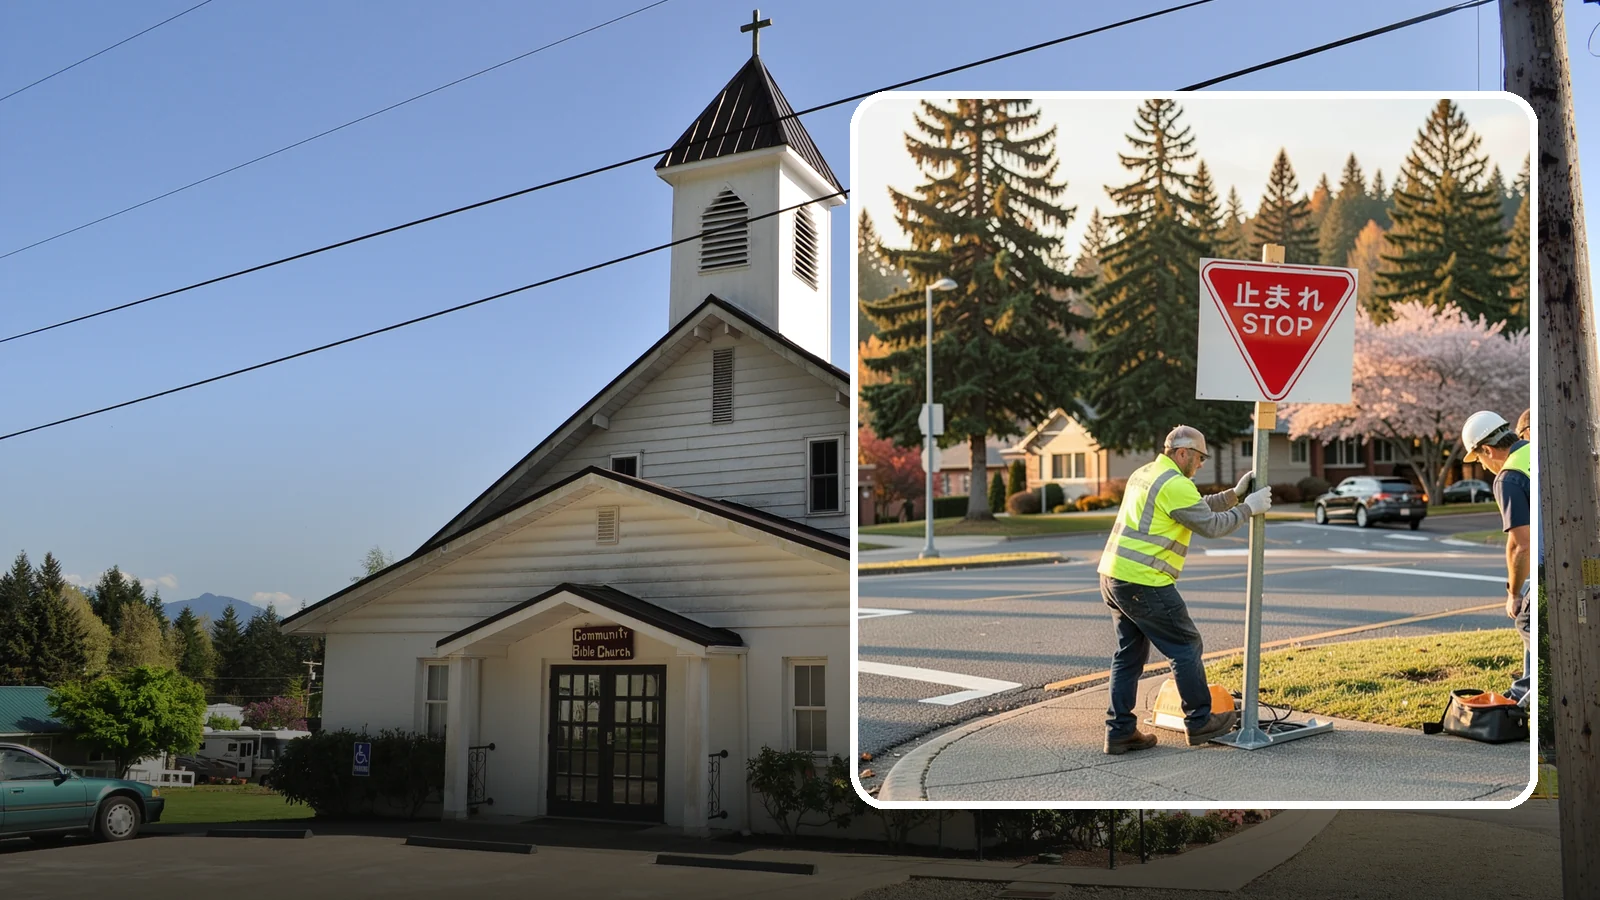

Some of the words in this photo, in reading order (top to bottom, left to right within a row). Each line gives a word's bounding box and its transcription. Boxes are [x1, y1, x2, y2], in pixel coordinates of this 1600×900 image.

[1233, 281, 1324, 311] 止まれ
[1242, 312, 1313, 336] STOP
[574, 627, 628, 641] Community
[572, 645, 595, 657] Bible
[597, 645, 631, 658] Church
